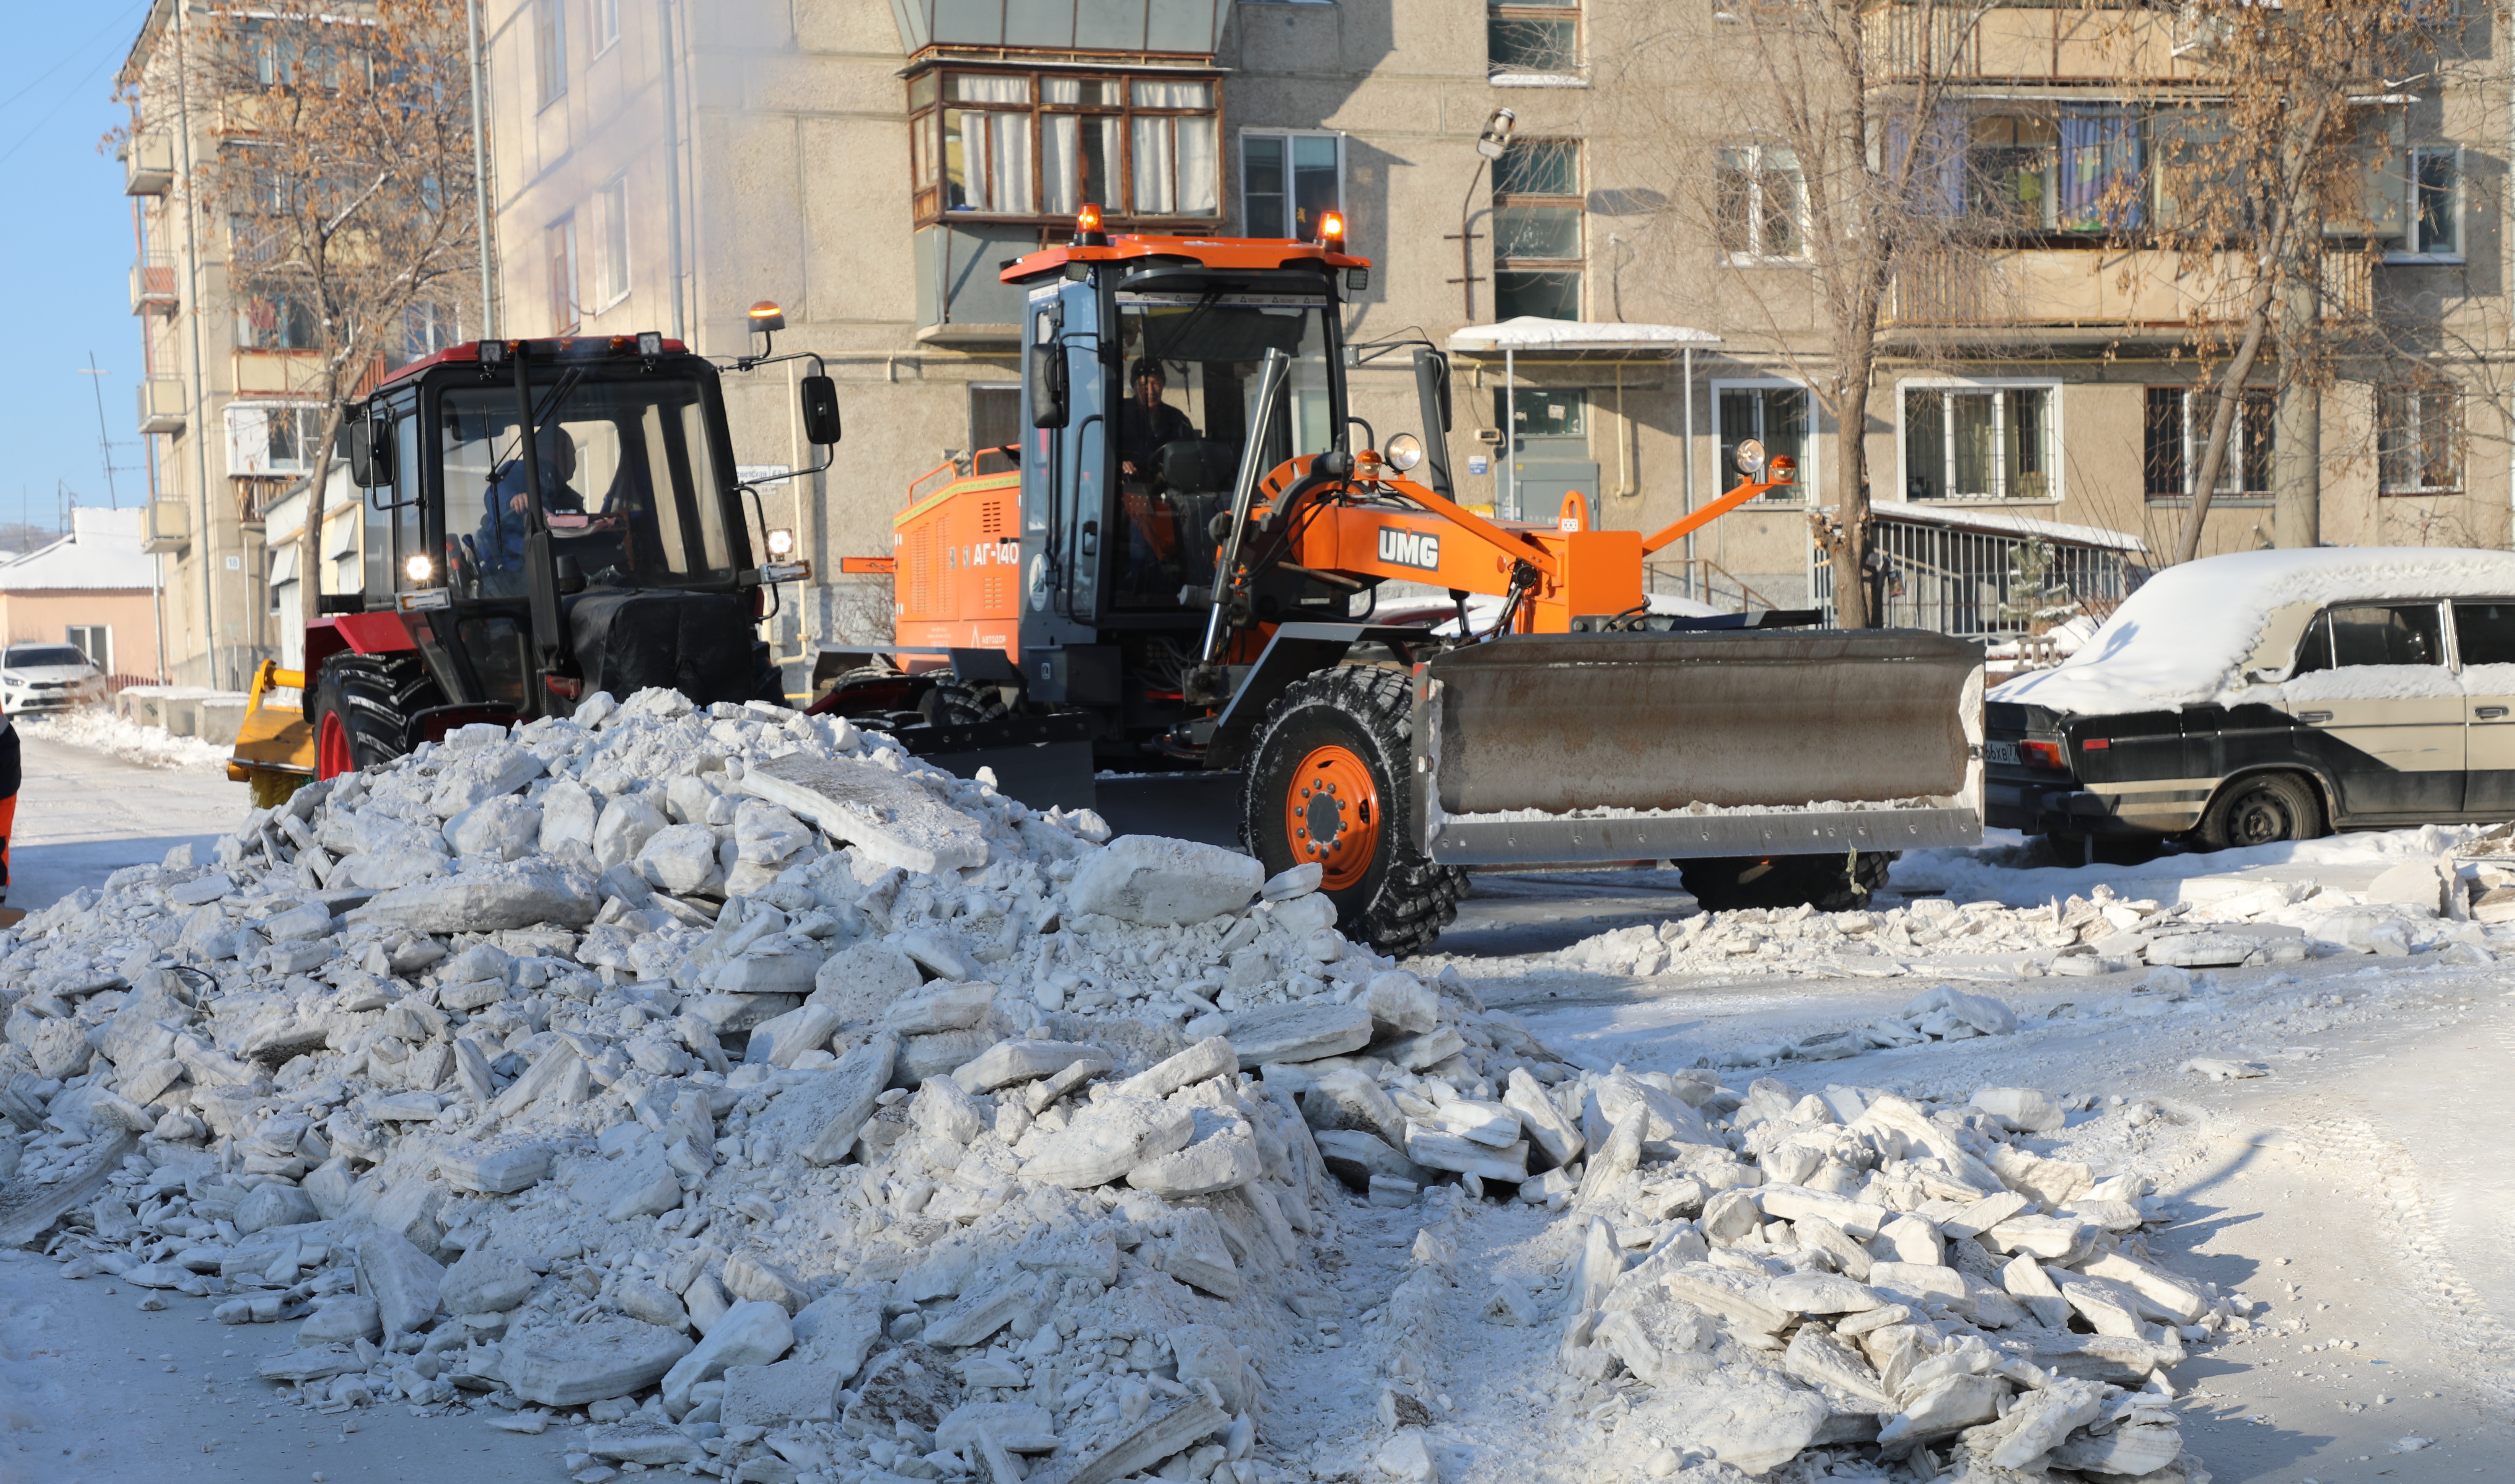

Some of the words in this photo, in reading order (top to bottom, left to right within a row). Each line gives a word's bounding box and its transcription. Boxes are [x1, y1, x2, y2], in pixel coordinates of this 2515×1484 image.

[973, 542, 1019, 565] АГ-140
[1379, 529, 1438, 568] UMG
[228, 558, 237, 567] 18
